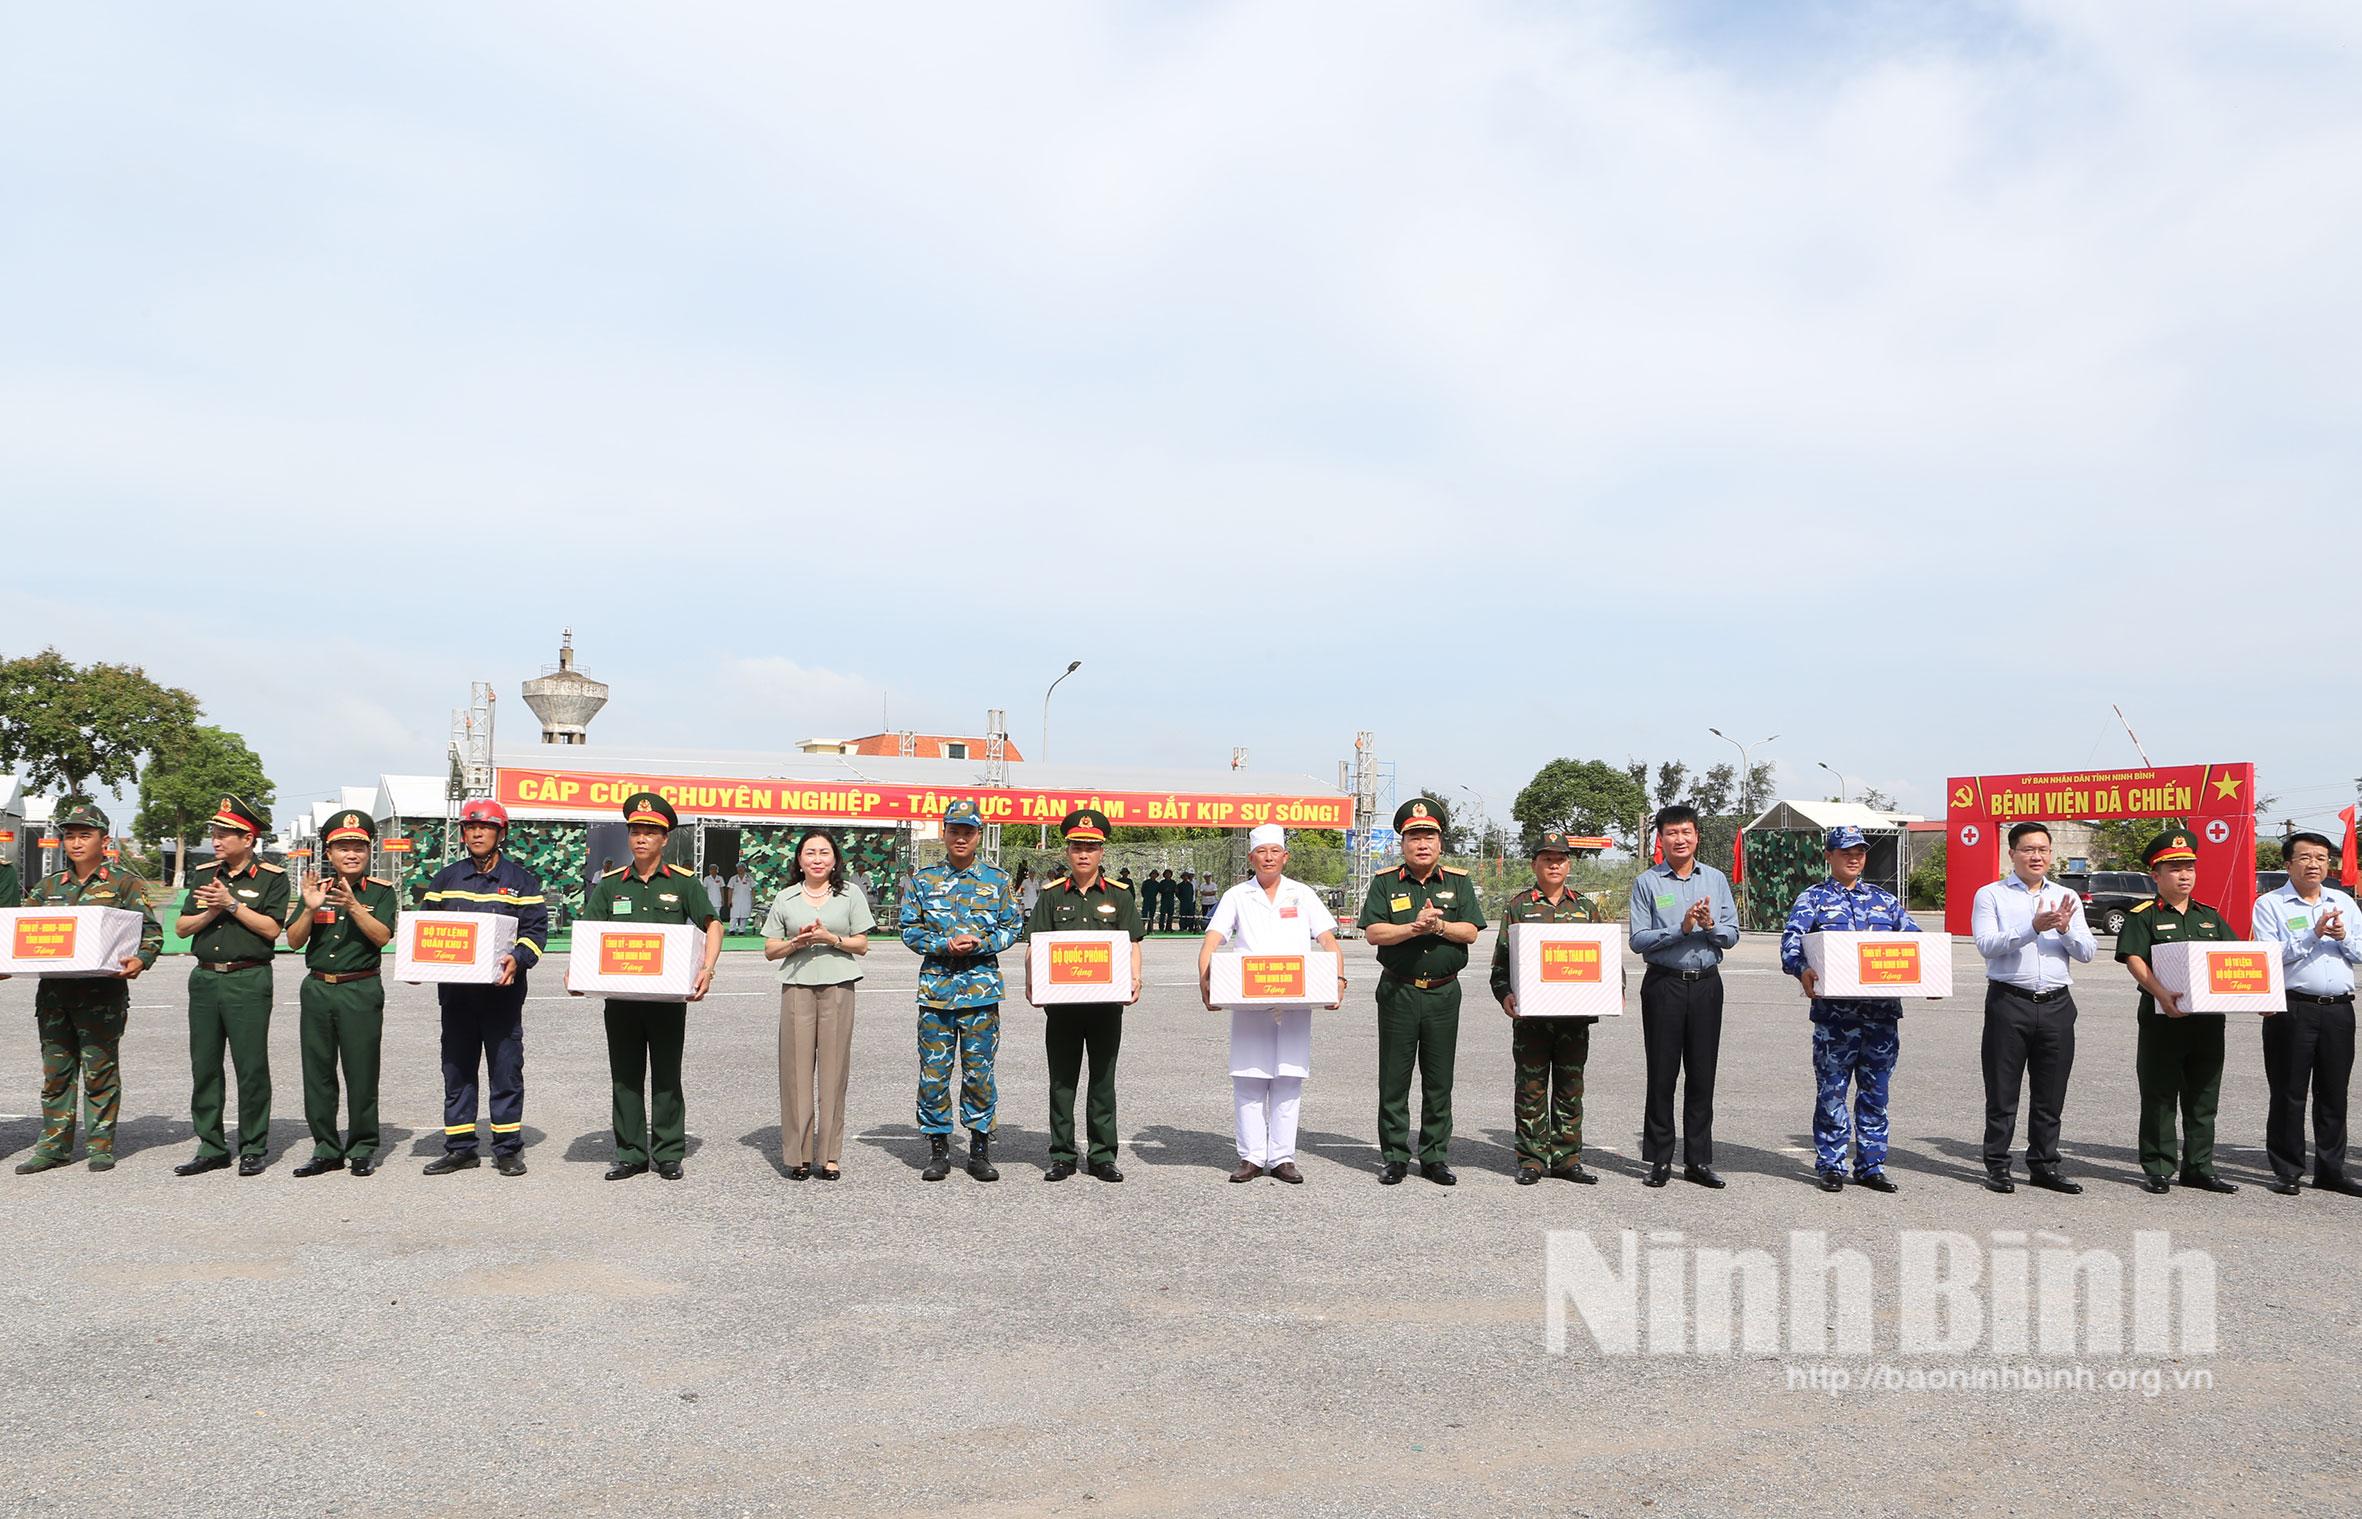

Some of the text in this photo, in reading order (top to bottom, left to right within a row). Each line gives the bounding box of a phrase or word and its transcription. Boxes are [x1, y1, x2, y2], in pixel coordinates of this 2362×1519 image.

[2033, 776, 2049, 784] BAN
[2050, 774, 2073, 784] NHÂN
[2074, 774, 2090, 783] DÂN
[2091, 773, 2111, 782] TỈNH
[2112, 772, 2133, 781] NINH
[2134, 770, 2155, 780] BÌNH
[518, 774, 580, 802] CẤP
[660, 784, 772, 809] CHUYÊN
[781, 789, 881, 816] NGHIỆP
[967, 796, 1013, 820] ỰC
[1020, 794, 1067, 821] TẬN
[1074, 796, 1125, 818] TÂM
[1148, 795, 1191, 820] BẮT
[1197, 801, 1235, 823] KỊP
[1240, 801, 1273, 825] SỰ
[1275, 799, 1340, 823] SỐNG!
[1991, 779, 2192, 820] BỆNH VIỆN DÃ CHIẾN
[423, 926, 435, 937] BỘ
[448, 927, 468, 938] LỆNH
[421, 938, 444, 948] QUÂN
[462, 940, 468, 950] 3
[1052, 945, 1108, 966] BỘ QUỐC PHÒNG
